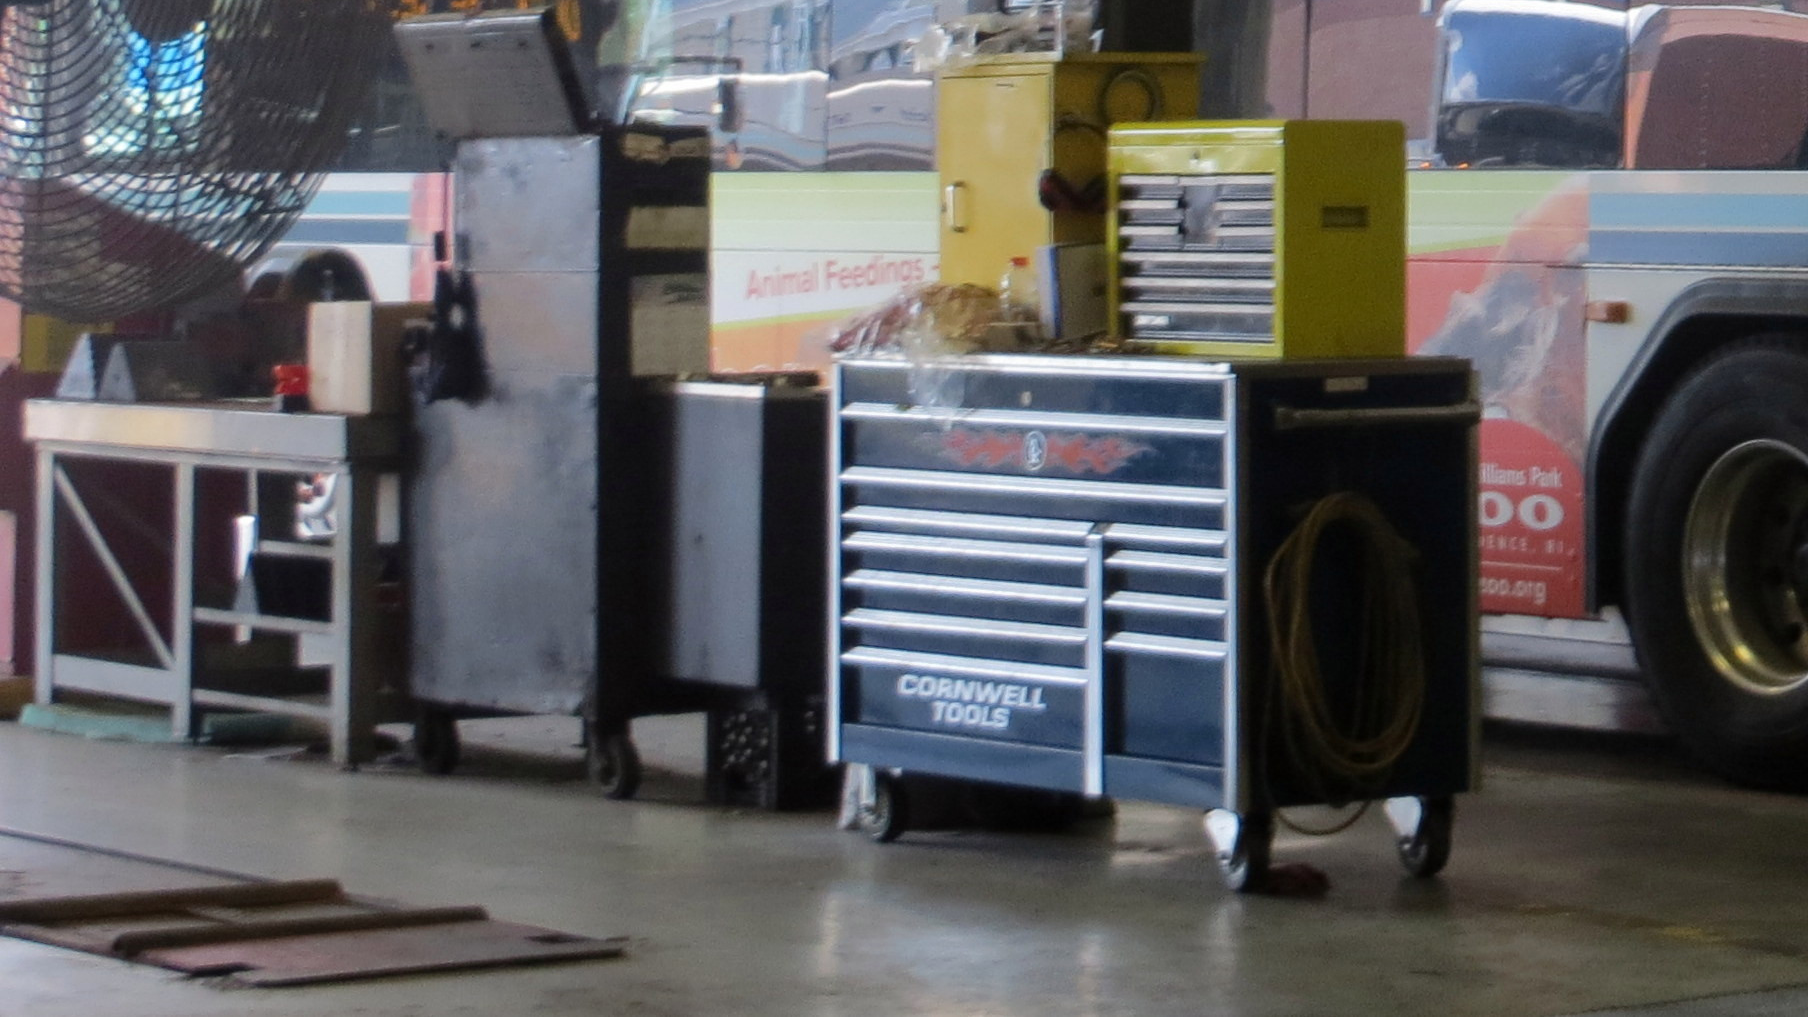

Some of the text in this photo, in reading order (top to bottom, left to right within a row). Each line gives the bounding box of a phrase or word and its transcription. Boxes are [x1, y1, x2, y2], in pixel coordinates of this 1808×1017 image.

[745, 254, 926, 300] Animal Feedings
[1480, 463, 1562, 487] illiams Park
[1479, 491, 1564, 530] OO
[898, 673, 1048, 710] CORNWELL
[933, 700, 1011, 729] TOOLS
